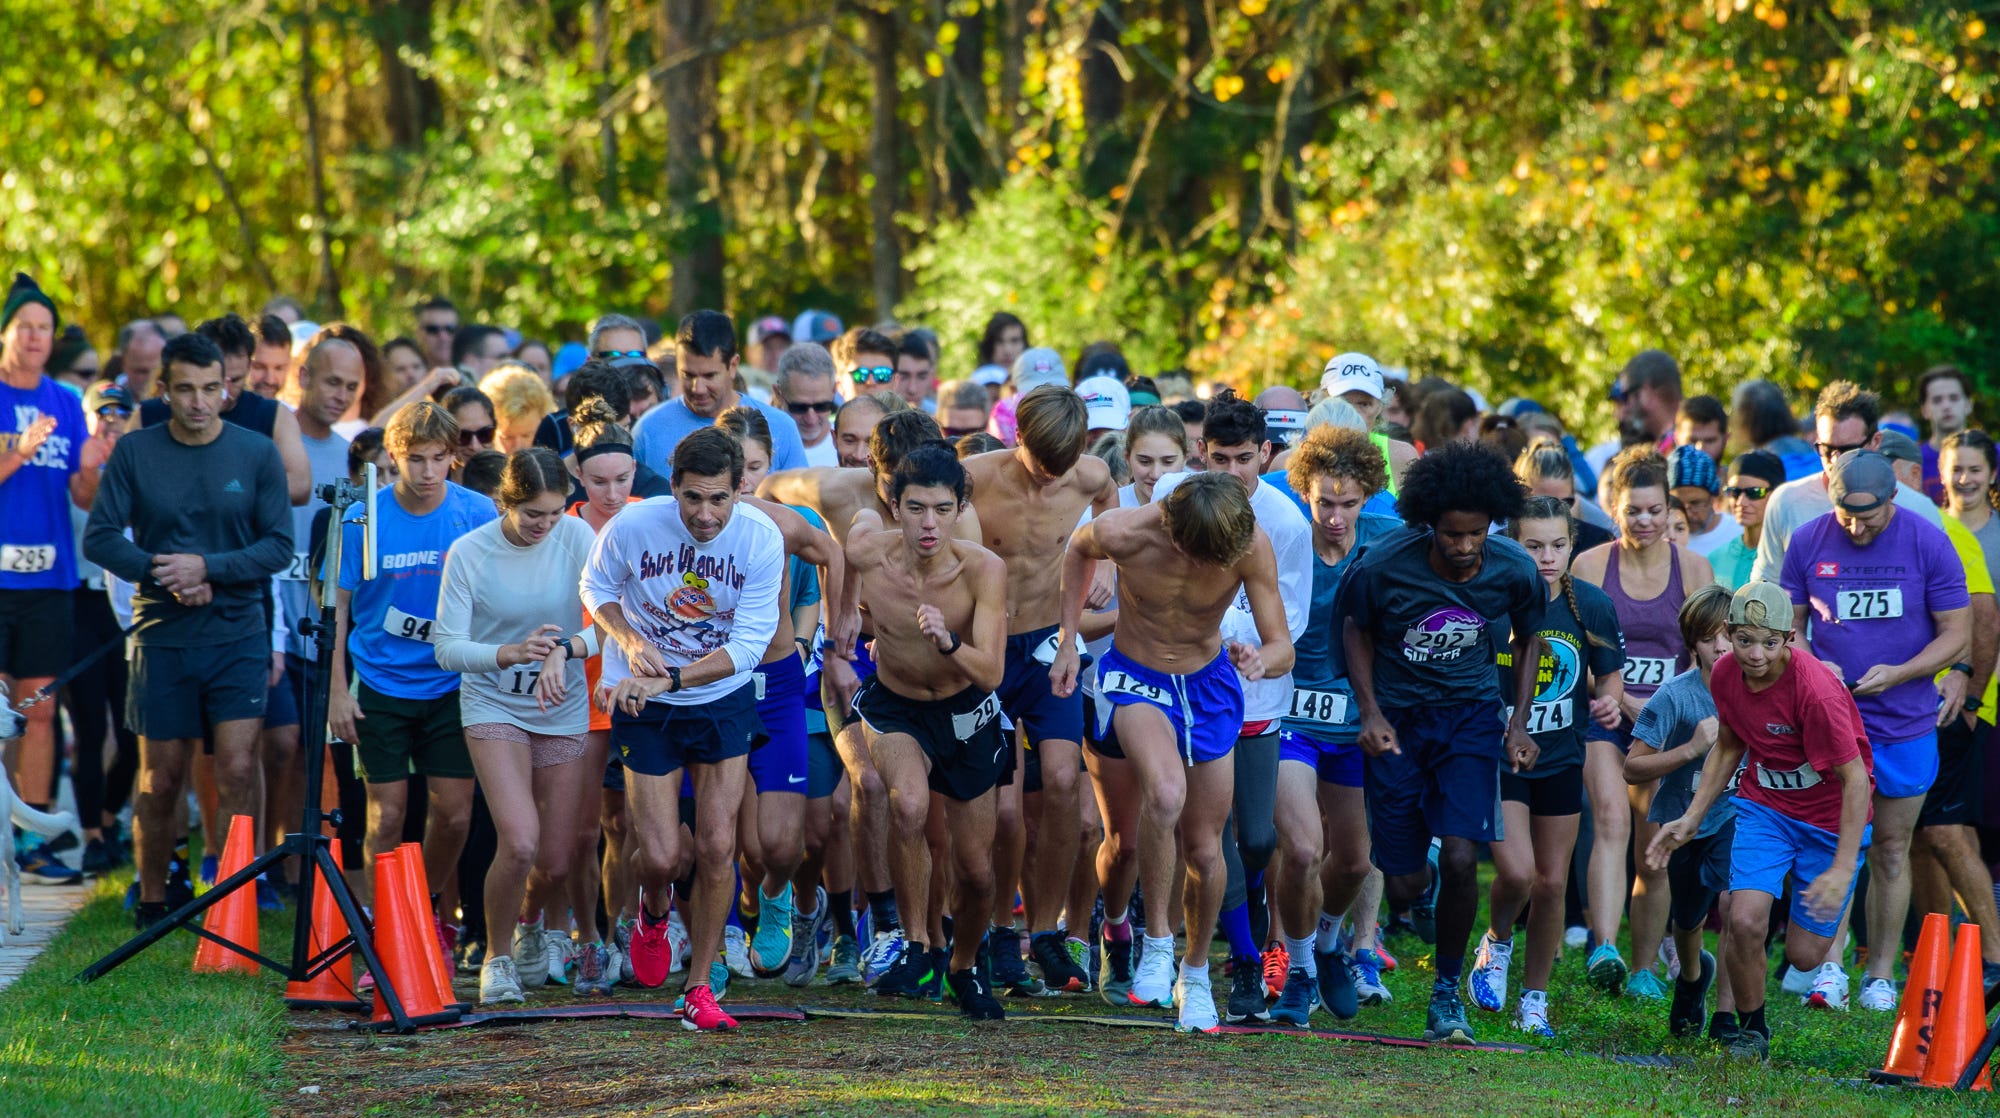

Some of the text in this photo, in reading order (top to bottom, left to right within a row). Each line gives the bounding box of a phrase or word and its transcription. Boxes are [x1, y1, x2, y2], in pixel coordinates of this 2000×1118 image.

[1341, 364, 1371, 377] OFC
[11, 548, 47, 570] 295
[382, 550, 440, 569] BOONE
[696, 555, 725, 582] and
[1848, 591, 1889, 617] 275
[401, 616, 433, 641] 94
[1415, 632, 1464, 649] 292
[1623, 659, 1665, 684] 273
[1115, 673, 1160, 699] 129
[973, 698, 994, 731] 29
[1289, 690, 1334, 721] 148
[1763, 767, 1804, 788] 117
